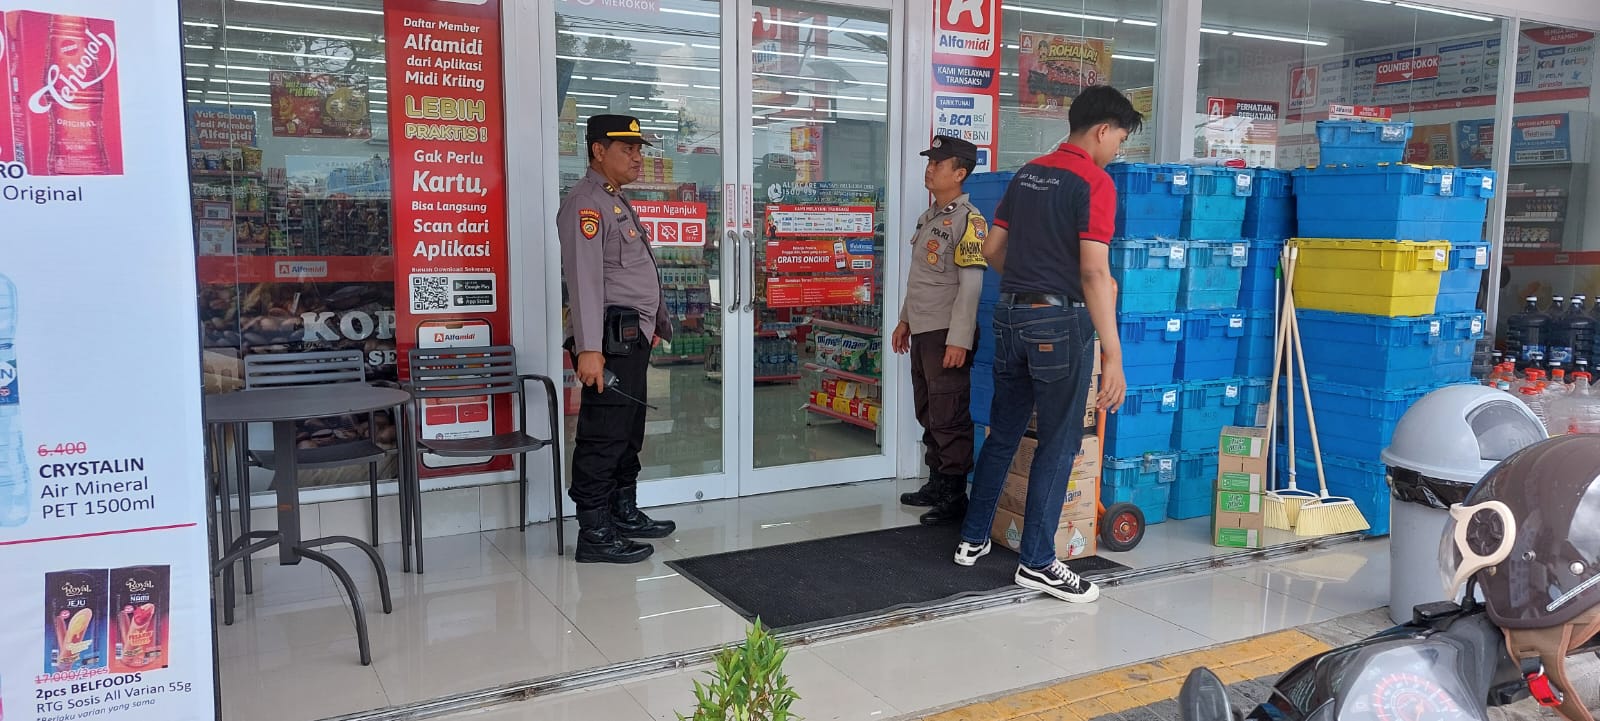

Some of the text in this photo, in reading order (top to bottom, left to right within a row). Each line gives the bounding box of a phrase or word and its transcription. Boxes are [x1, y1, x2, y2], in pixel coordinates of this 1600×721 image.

[403, 17, 480, 33] Daftar Member
[403, 33, 483, 56] Alfamidi
[939, 34, 990, 52] Alfamidi
[407, 55, 482, 72] dari Aplikasi
[1378, 62, 1410, 74] COUNTER
[1411, 58, 1439, 70] ROKOK
[937, 66, 991, 77] KAMI MELAYANI
[405, 70, 485, 92] Midi Kriing
[946, 75, 983, 85] TRANSAKSI
[405, 95, 485, 122] LEBIH
[1236, 102, 1275, 113] PERHATIAN,
[57, 118, 97, 127] ORIGINAL
[217, 111, 253, 121] Gabung
[950, 114, 972, 126] BCA
[196, 120, 255, 130] Jadi Member
[199, 129, 252, 141] Alfamidi
[973, 130, 989, 141] BNI
[413, 150, 483, 165] Gak Perlu
[412, 170, 487, 197] Kartu,
[3, 186, 82, 204] Original
[411, 201, 487, 214] Bisa Langsung
[663, 205, 698, 216] Nganjuk
[413, 218, 489, 234] Scan dari
[930, 227, 950, 240] POLRI
[413, 240, 490, 261] Aplikasi
[777, 256, 802, 264] GRATIS
[444, 332, 475, 341] Alfamidi
[38, 442, 87, 457] 6.400
[39, 457, 144, 480] CRYSTALIN
[41, 475, 148, 500] Air Mineral
[42, 494, 155, 520] PET 1500ml
[67, 599, 87, 607] JEJU
[36, 672, 142, 701] 2pcs BELFOODS
[37, 681, 192, 713] RTG Sosis All Varian 55g
[77, 706, 106, 719] varian
[109, 702, 130, 715] yang
[132, 698, 156, 708] sama
